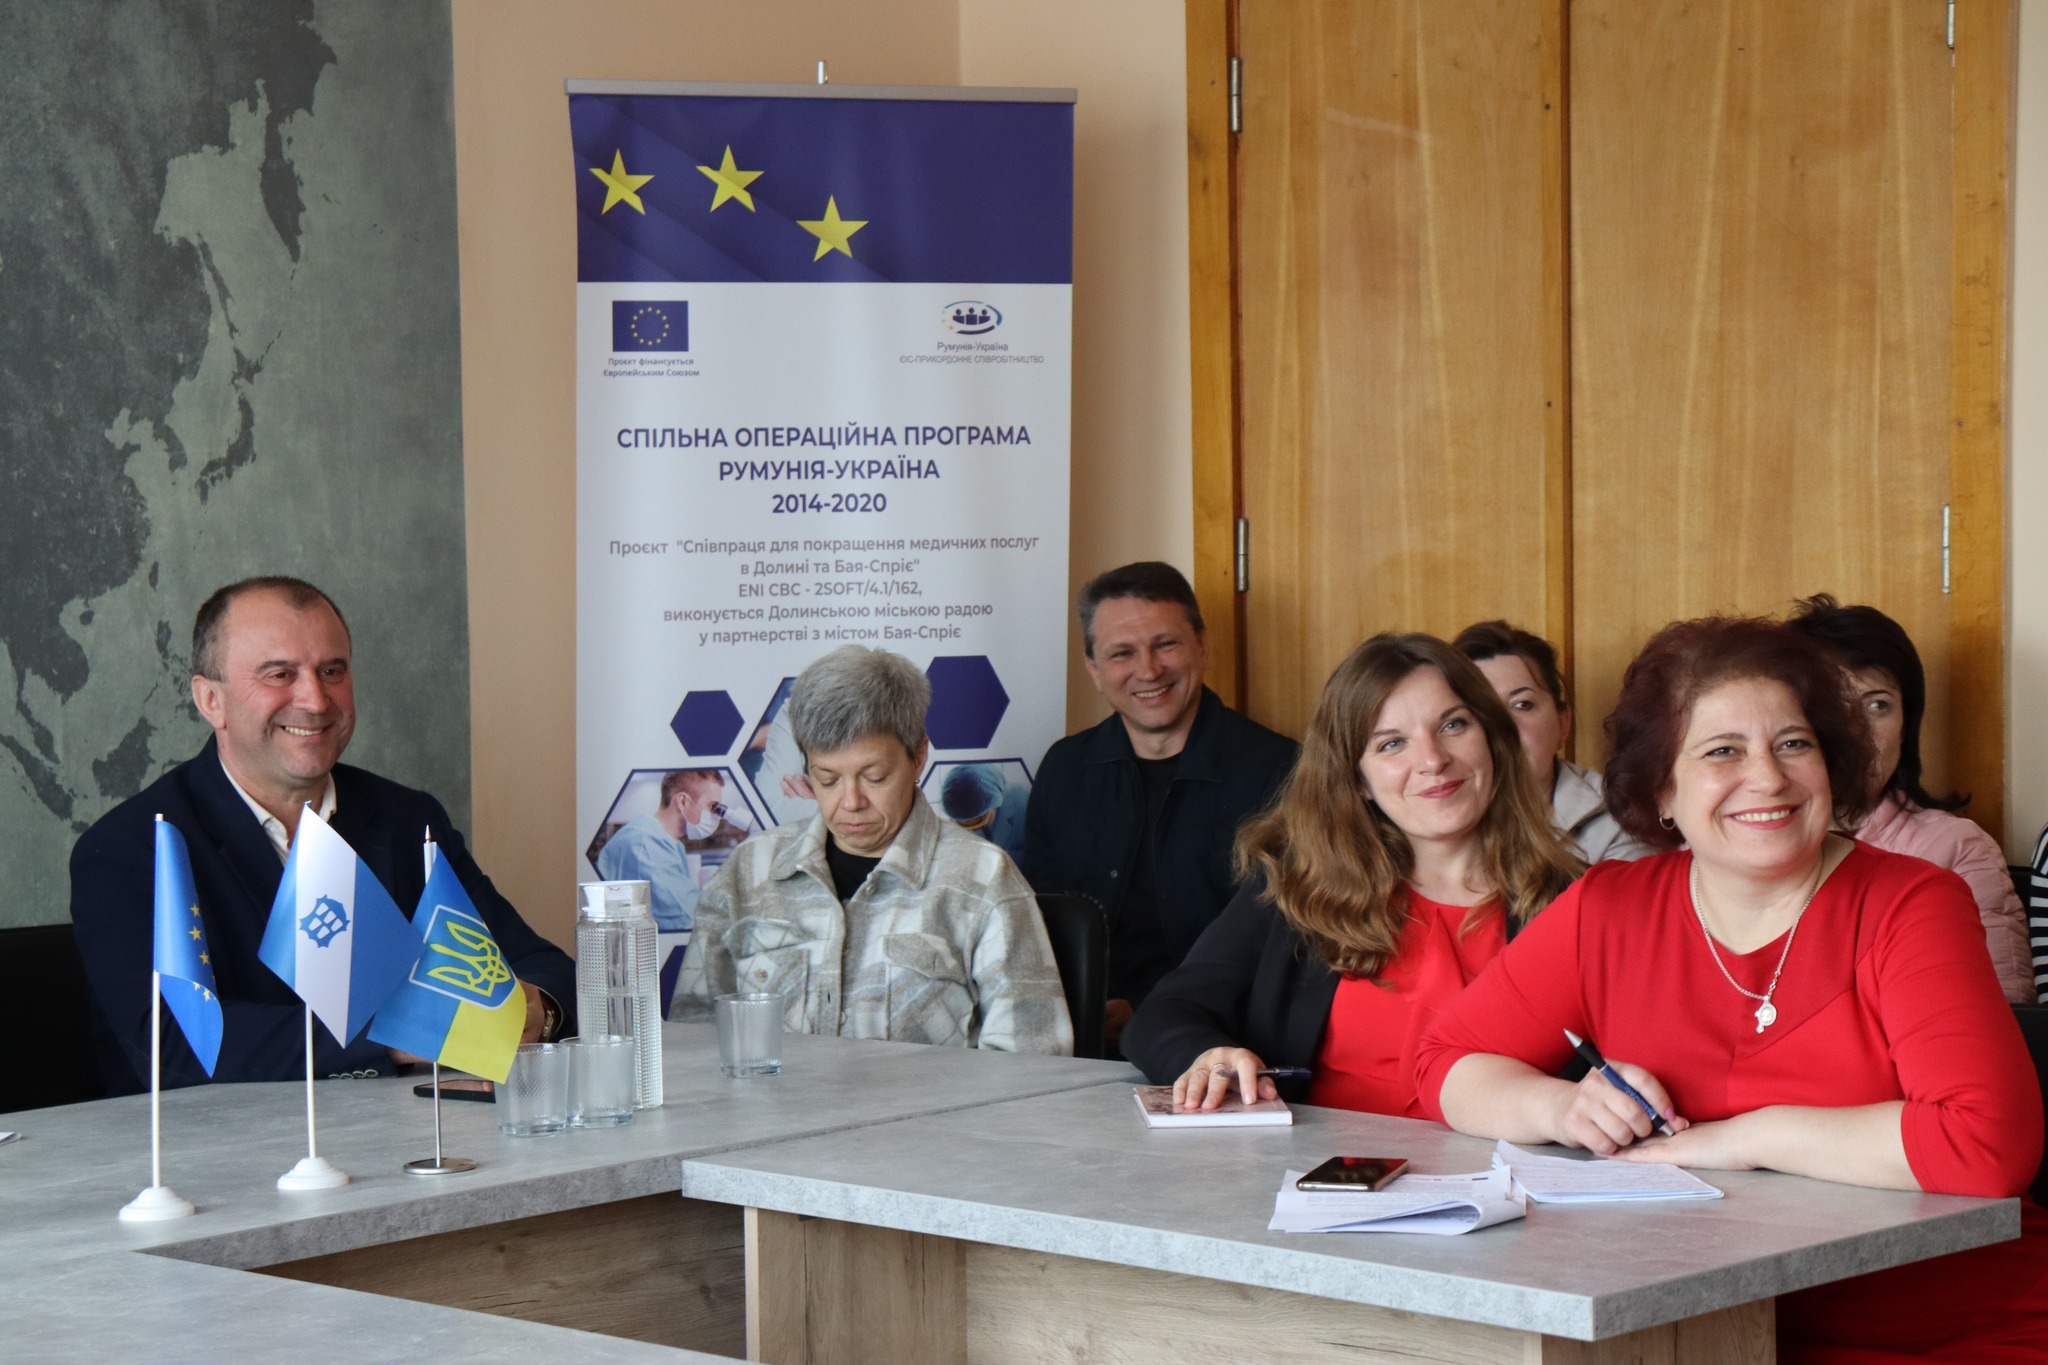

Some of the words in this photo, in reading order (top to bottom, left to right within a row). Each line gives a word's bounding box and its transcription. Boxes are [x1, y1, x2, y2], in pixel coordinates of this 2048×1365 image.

[937, 341, 1009, 353] Румунія-Україна
[603, 368, 664, 378] Європейським
[666, 368, 700, 377] Союзом
[608, 358, 636, 366] Проєкт
[639, 357, 694, 367] фінансується
[616, 427, 729, 449] СПІЛЬНА
[734, 420, 898, 451] ОПЕРАЦІЙНА
[903, 424, 1032, 447] ПРОГРАМА
[718, 453, 941, 482] РУМУНІЯ-УКРАЇНА
[771, 492, 888, 515] 2014-2020
[609, 540, 669, 558] Проєкт
[676, 537, 766, 557] "Співпраця
[769, 540, 799, 554] для
[803, 539, 906, 555] покращення
[909, 537, 988, 552] медичних
[990, 536, 1040, 552] послуг
[740, 563, 750, 576] в
[752, 558, 810, 578] Долині
[812, 562, 830, 574] та
[834, 557, 920, 576] Бая-Спріє"
[738, 583, 765, 598] ENI
[768, 582, 801, 597] CBC
[814, 578, 923, 597] 2SOFT/4.1/162,
[663, 608, 764, 625] виконується
[767, 604, 871, 622] Долинською
[874, 602, 941, 618] міською
[944, 604, 994, 620] радою
[698, 632, 709, 647] у
[712, 626, 808, 647] партнерстві
[811, 629, 821, 641] з
[824, 624, 879, 640] містом
[883, 623, 962, 642] Бая-Спріє
